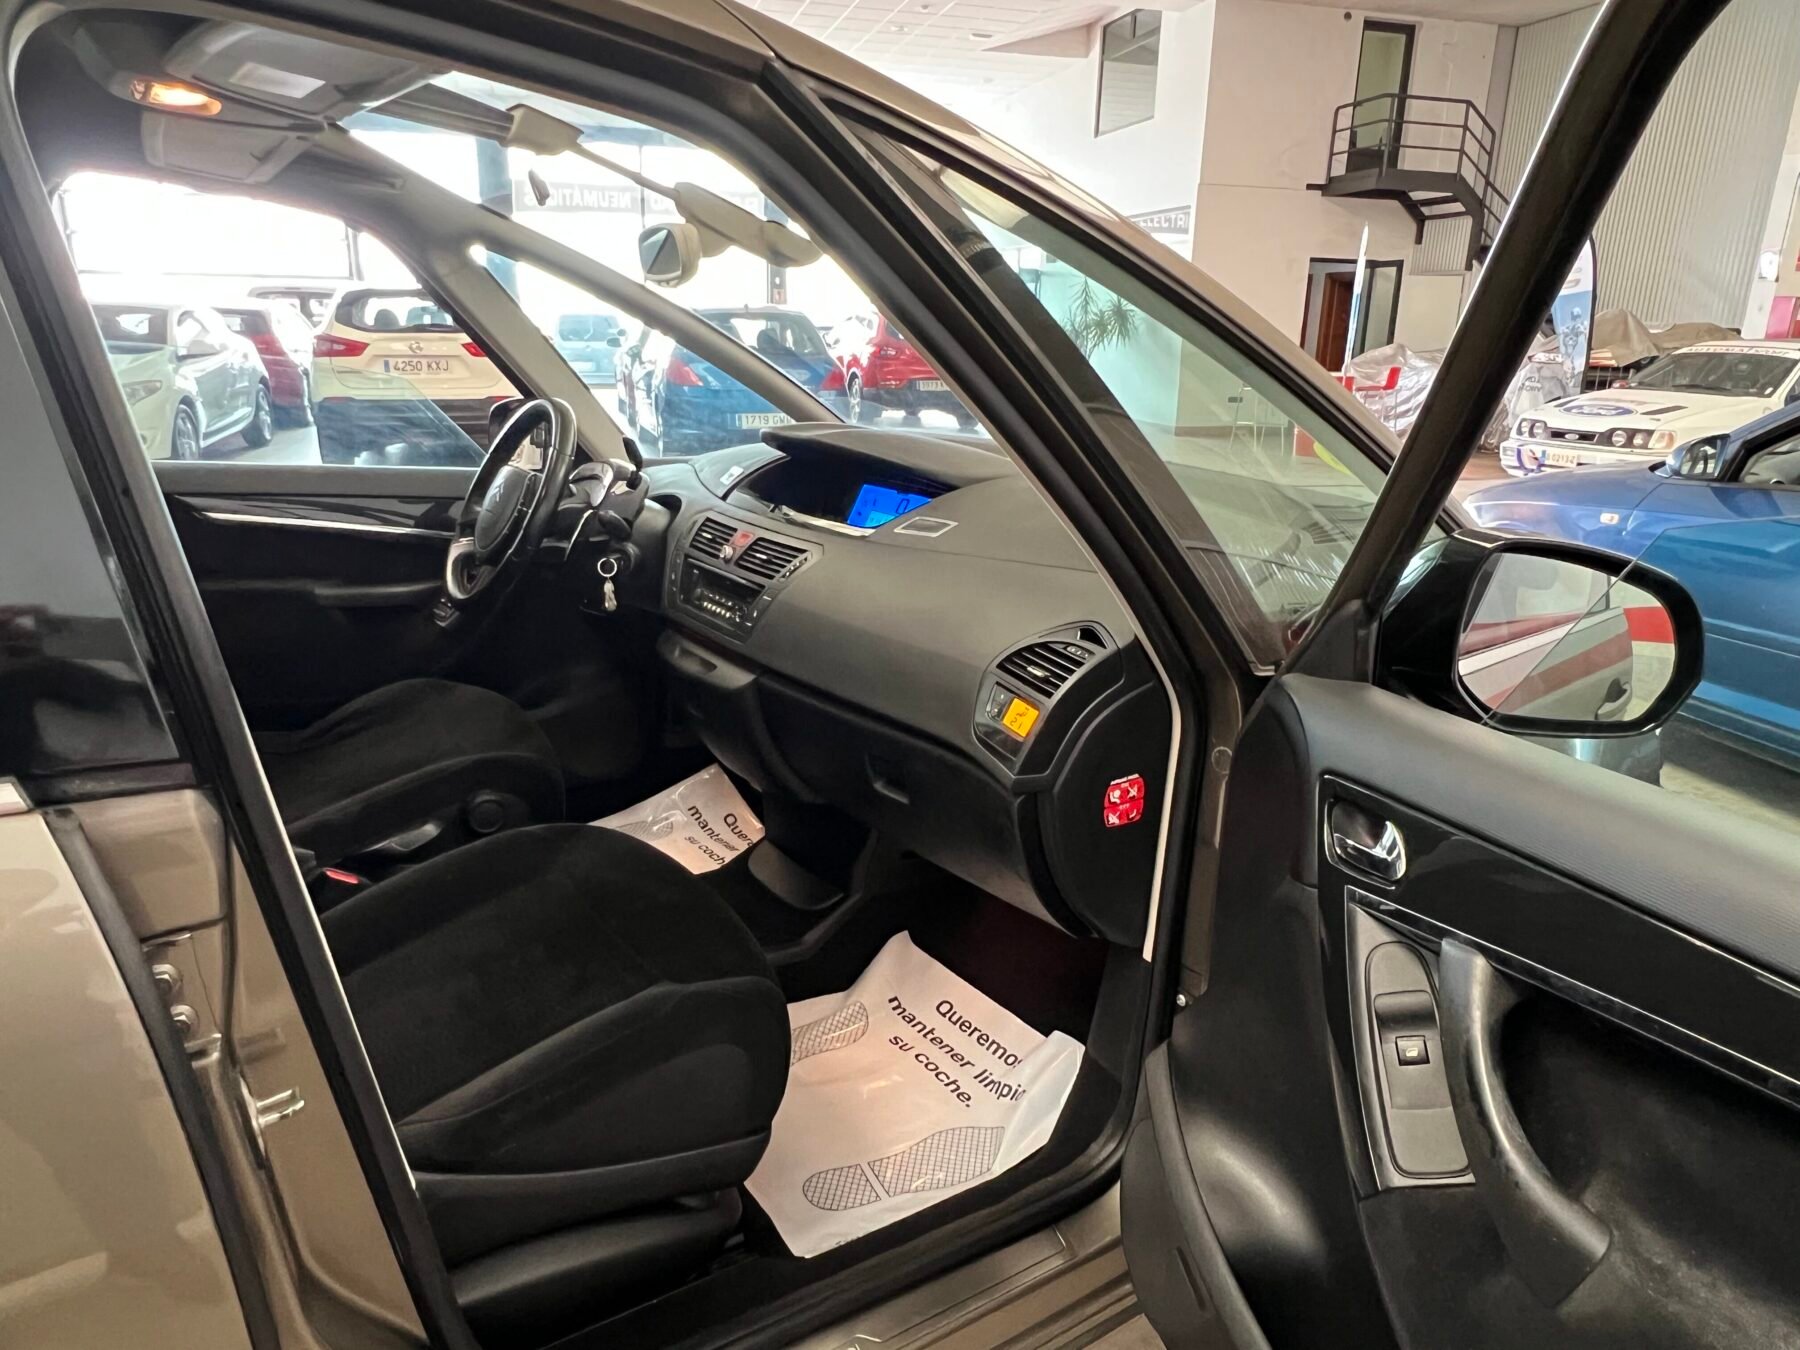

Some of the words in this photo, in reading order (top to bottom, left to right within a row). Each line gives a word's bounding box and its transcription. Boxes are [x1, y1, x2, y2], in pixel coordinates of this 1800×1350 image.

[393, 360, 423, 372] 4250
[426, 359, 449, 372] KXJ
[745, 415, 770, 425] 1719
[687, 805, 740, 852] mantener
[887, 995, 976, 1068] mantener
[888, 1034, 916, 1053] su
[914, 1052, 972, 1108] coche.
